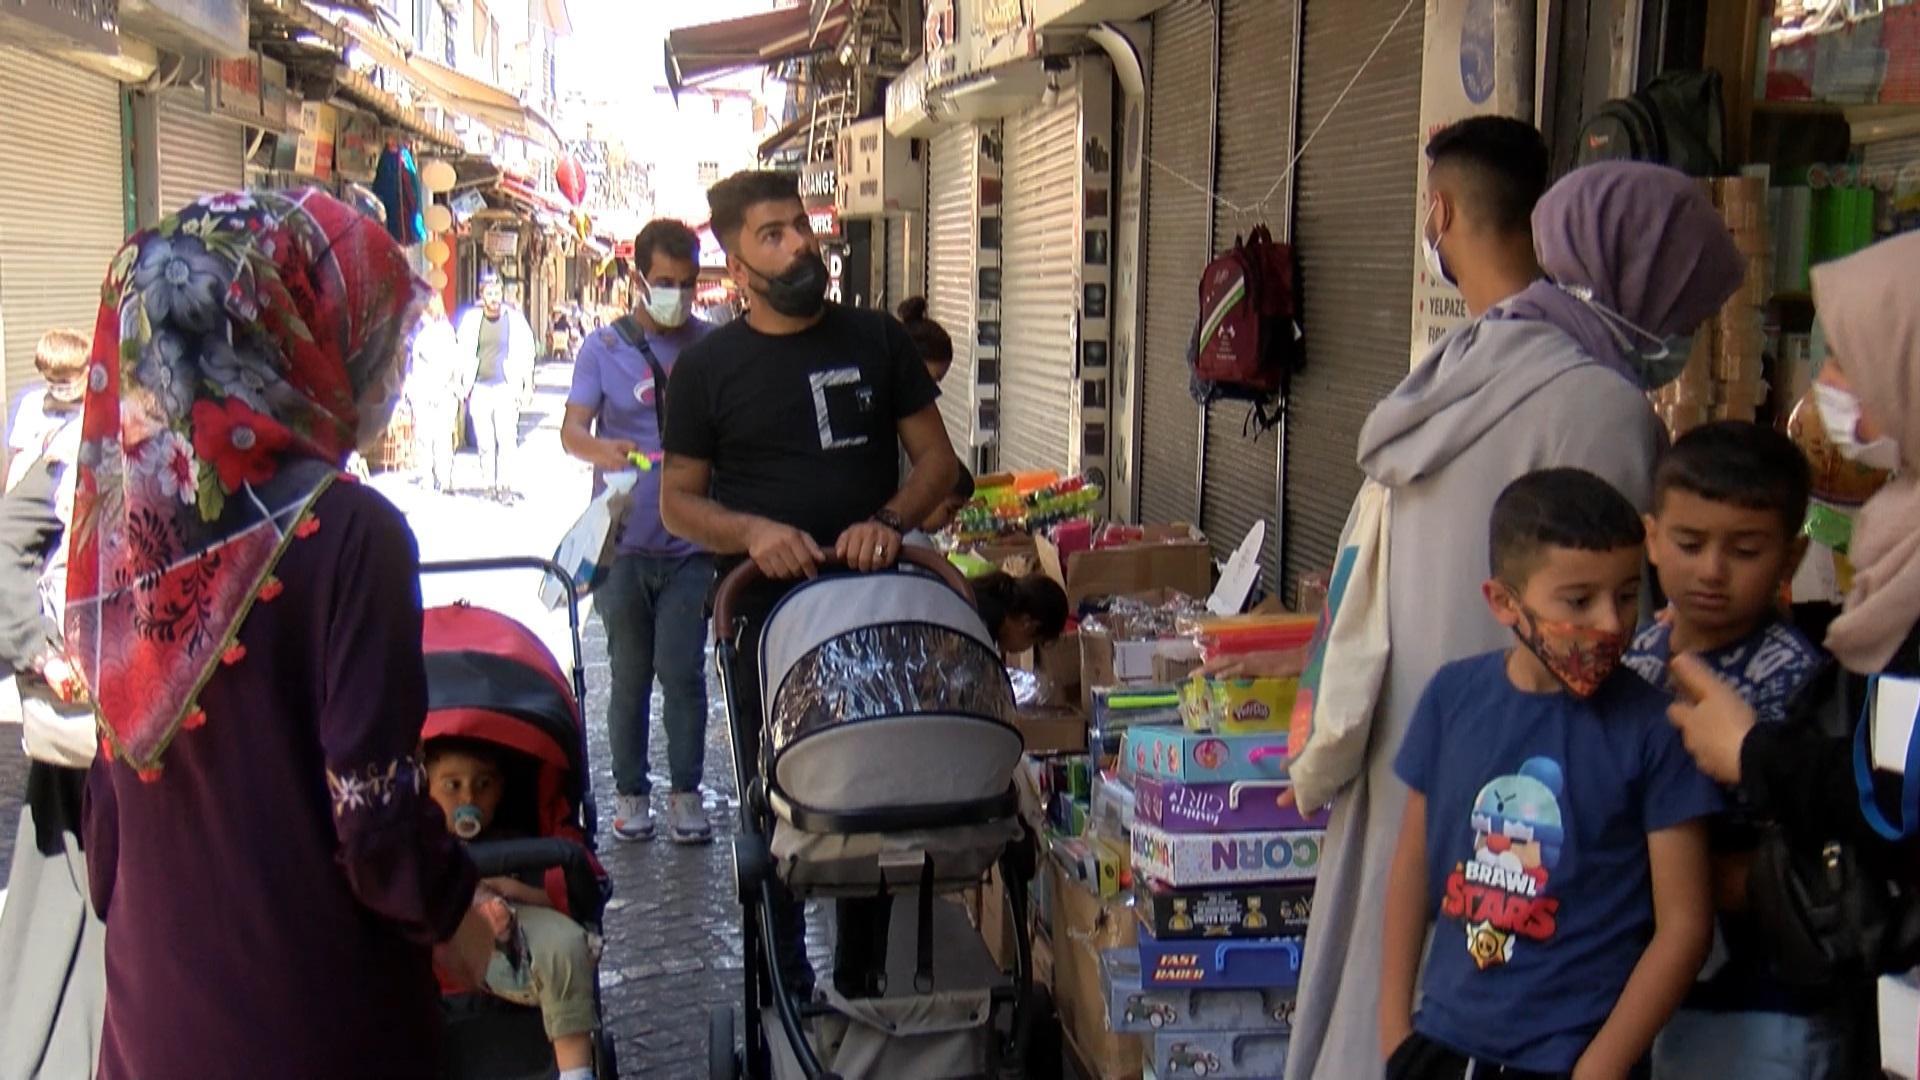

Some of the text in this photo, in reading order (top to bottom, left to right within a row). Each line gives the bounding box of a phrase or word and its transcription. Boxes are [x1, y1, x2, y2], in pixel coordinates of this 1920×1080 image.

[1429, 296, 1466, 318] YELPAZE
[1465, 860, 1537, 896] BRAWL
[1445, 869, 1559, 940] STARS
